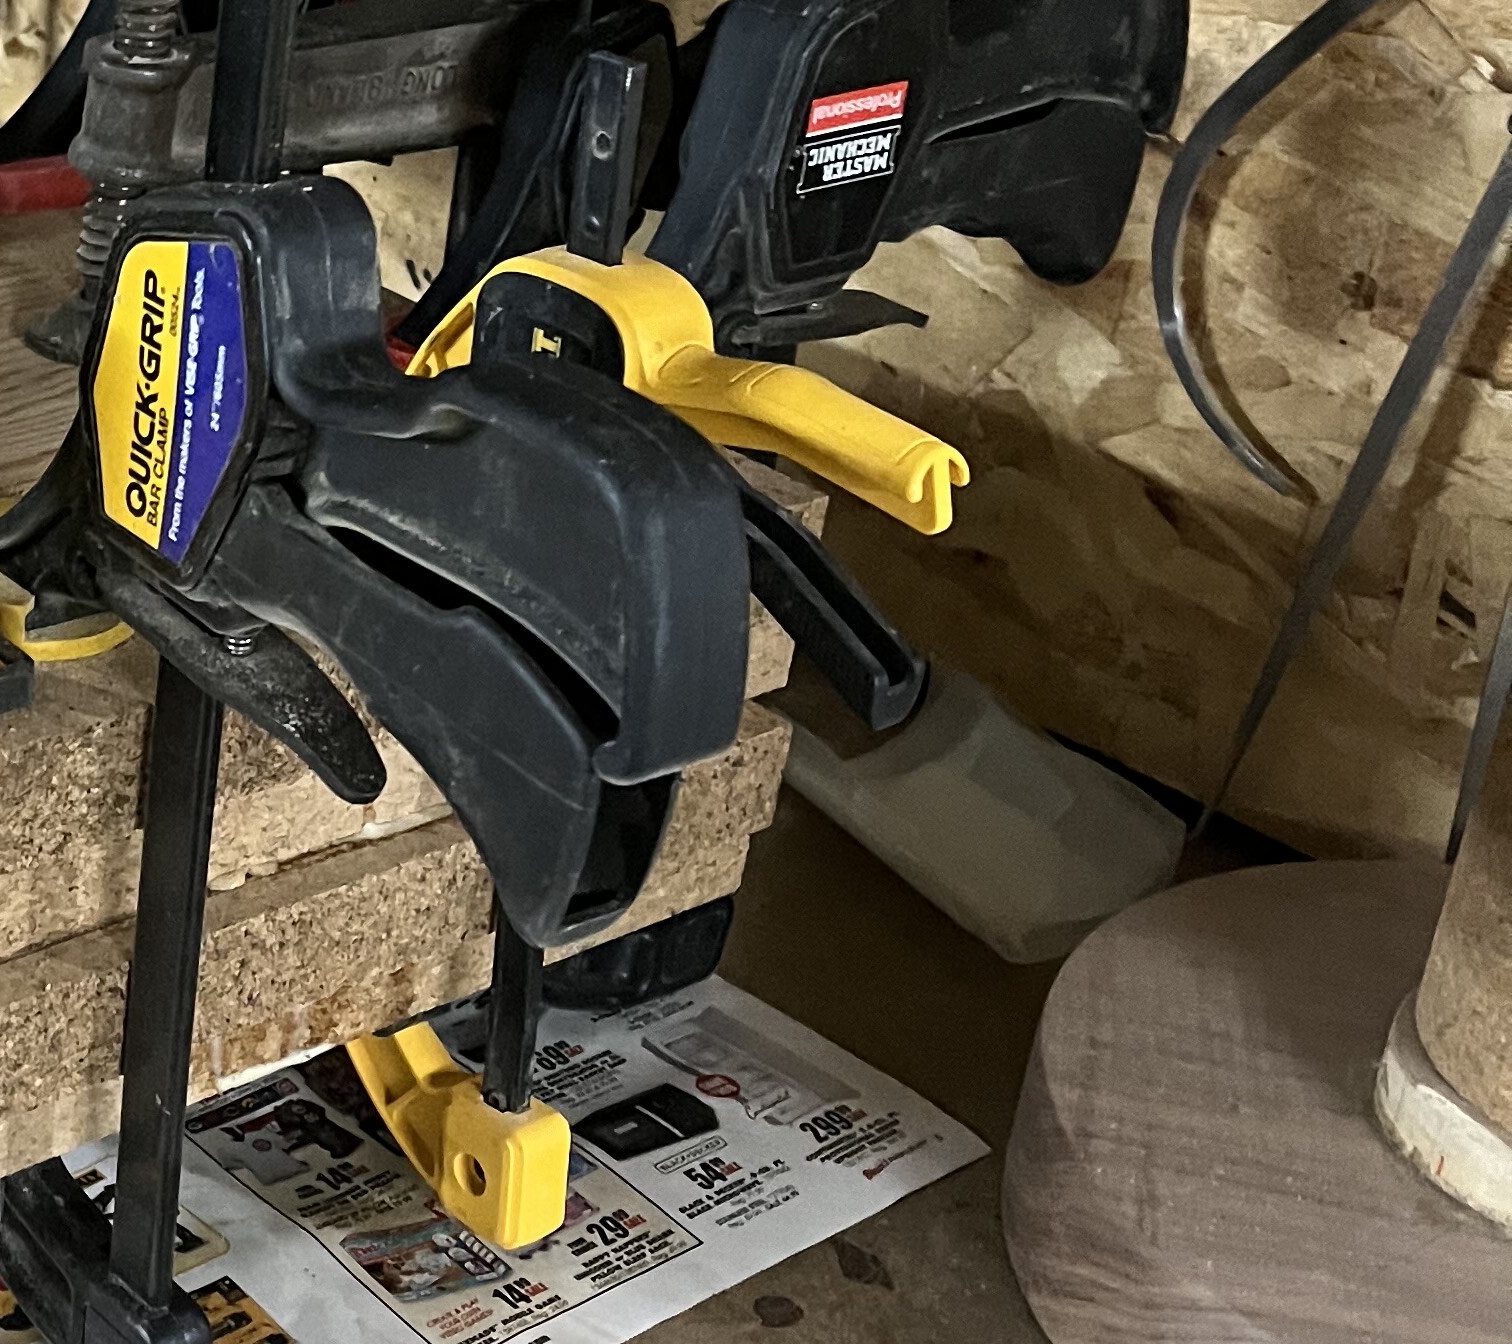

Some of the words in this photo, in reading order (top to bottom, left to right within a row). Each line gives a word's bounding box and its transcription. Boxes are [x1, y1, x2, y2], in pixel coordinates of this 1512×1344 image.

[812, 89, 902, 123] Professional
[808, 133, 891, 167] MECHANIC
[823, 152, 889, 182] MASTER
[183, 397, 193, 418] of
[152, 407, 169, 479] CLAMP
[177, 421, 193, 473] makers
[147, 481, 162, 526] BAR
[173, 474, 185, 502] the
[169, 504, 182, 541] From
[799, 1110, 853, 1143] 299
[683, 1162, 728, 1189] 54
[586, 1216, 629, 1245] 29
[492, 1283, 533, 1310] 14
